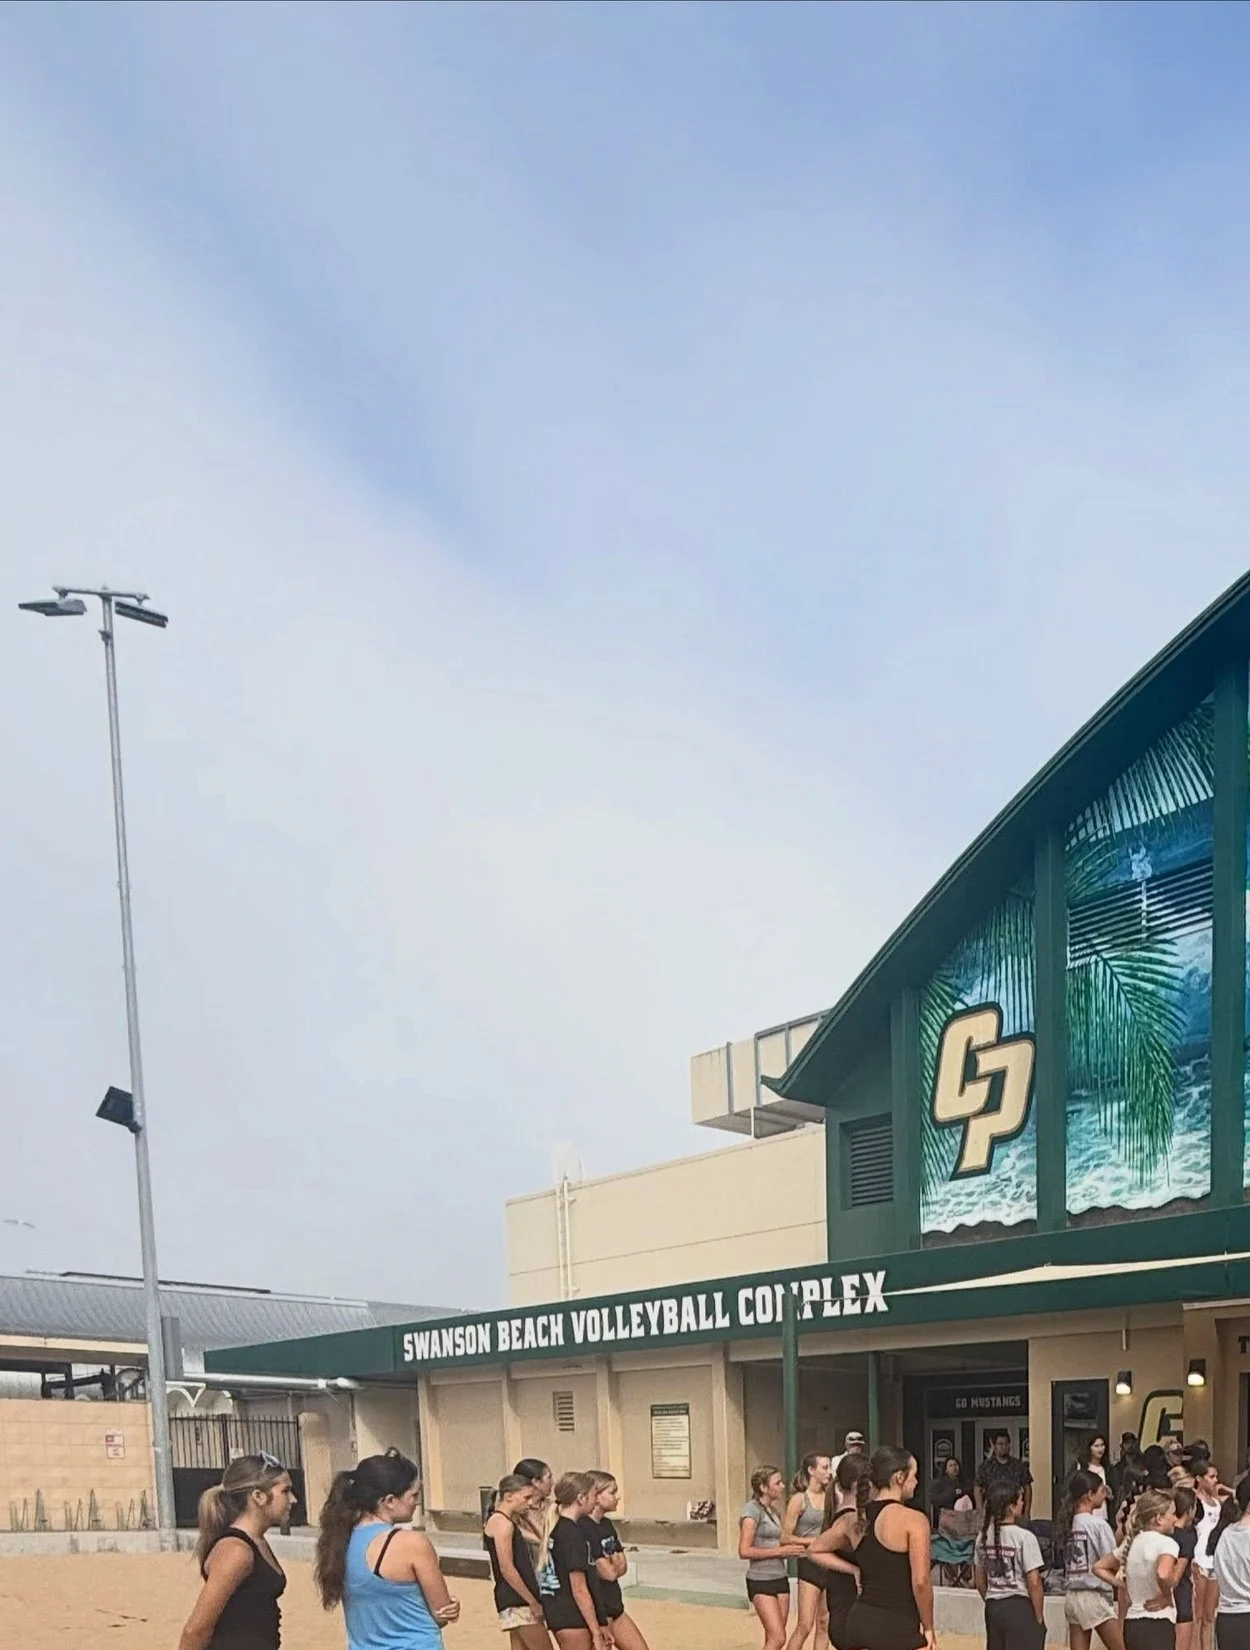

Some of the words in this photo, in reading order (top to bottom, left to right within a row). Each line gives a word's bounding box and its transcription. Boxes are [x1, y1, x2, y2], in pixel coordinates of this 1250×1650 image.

[403, 1322, 491, 1362] SWANSON
[497, 1313, 565, 1352] BEACH
[571, 1291, 730, 1344] VOLLEYBALL
[955, 1398, 968, 1409] GO
[970, 1395, 1021, 1409] MUSTANGS
